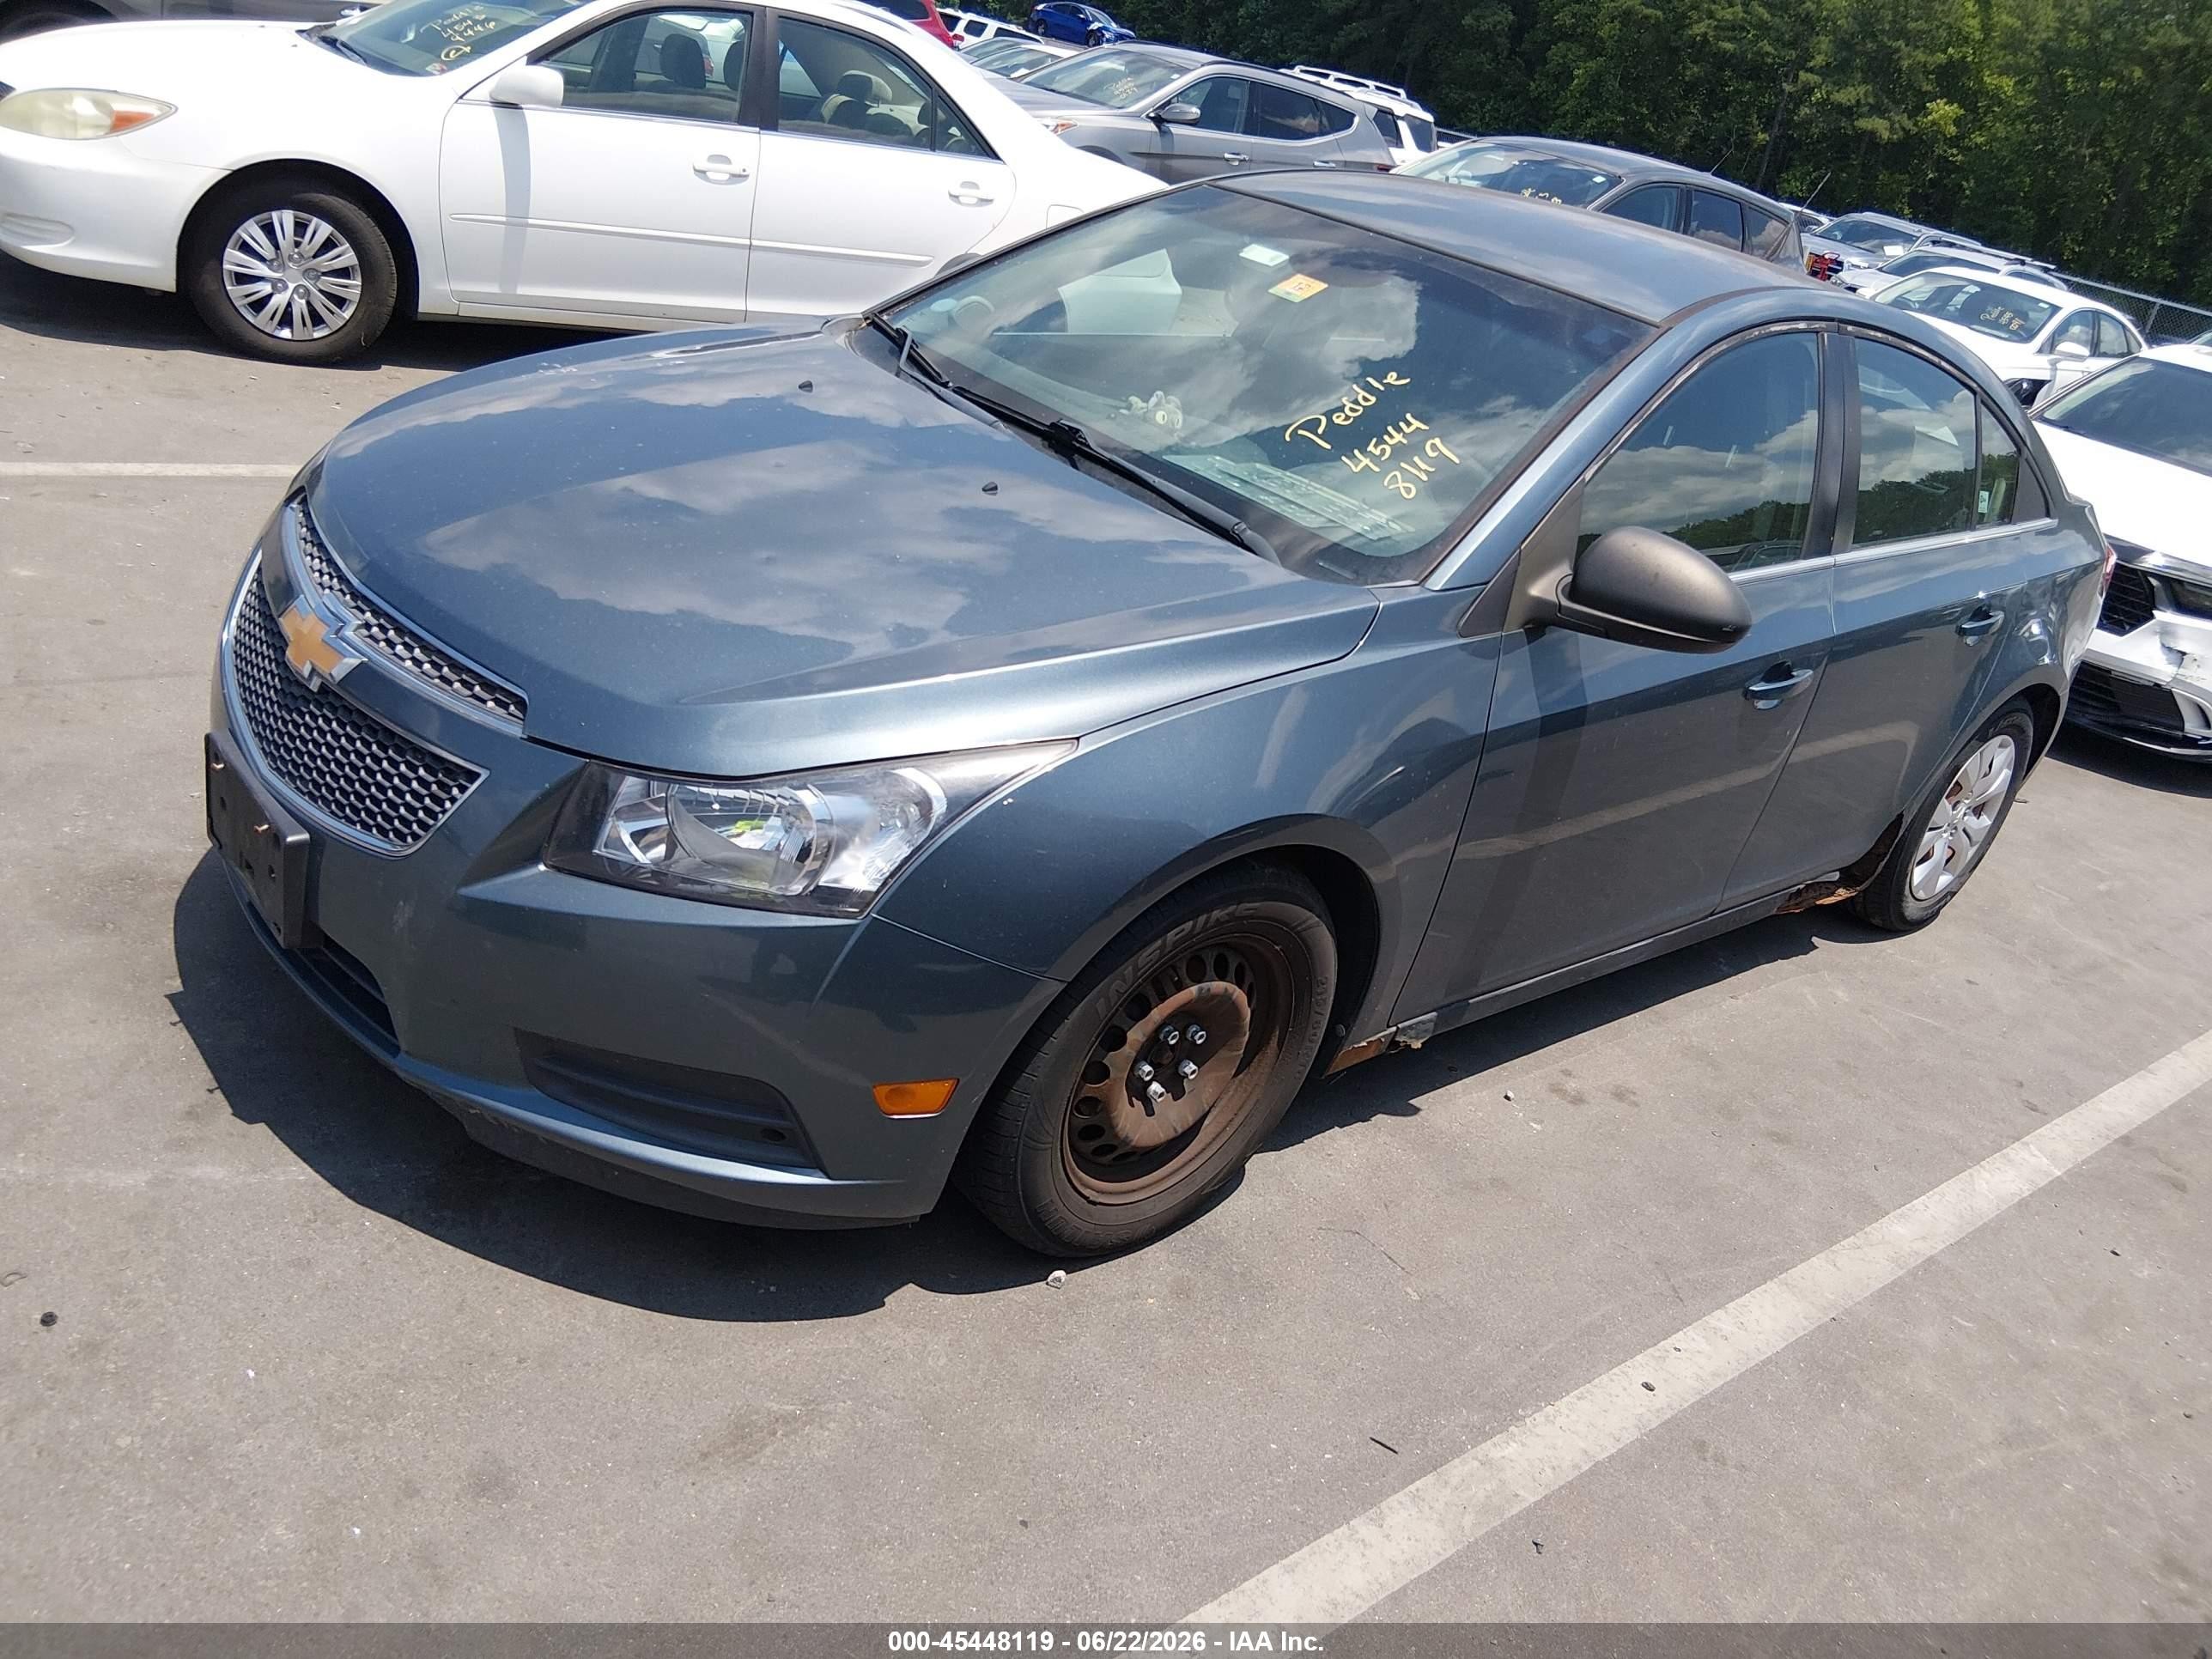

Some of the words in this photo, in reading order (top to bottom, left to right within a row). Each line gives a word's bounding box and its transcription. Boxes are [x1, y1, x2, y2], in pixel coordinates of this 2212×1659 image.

[1285, 371, 1411, 450] Peddle
[1340, 412, 1430, 473] 4544
[1383, 437, 1461, 500] 8119
